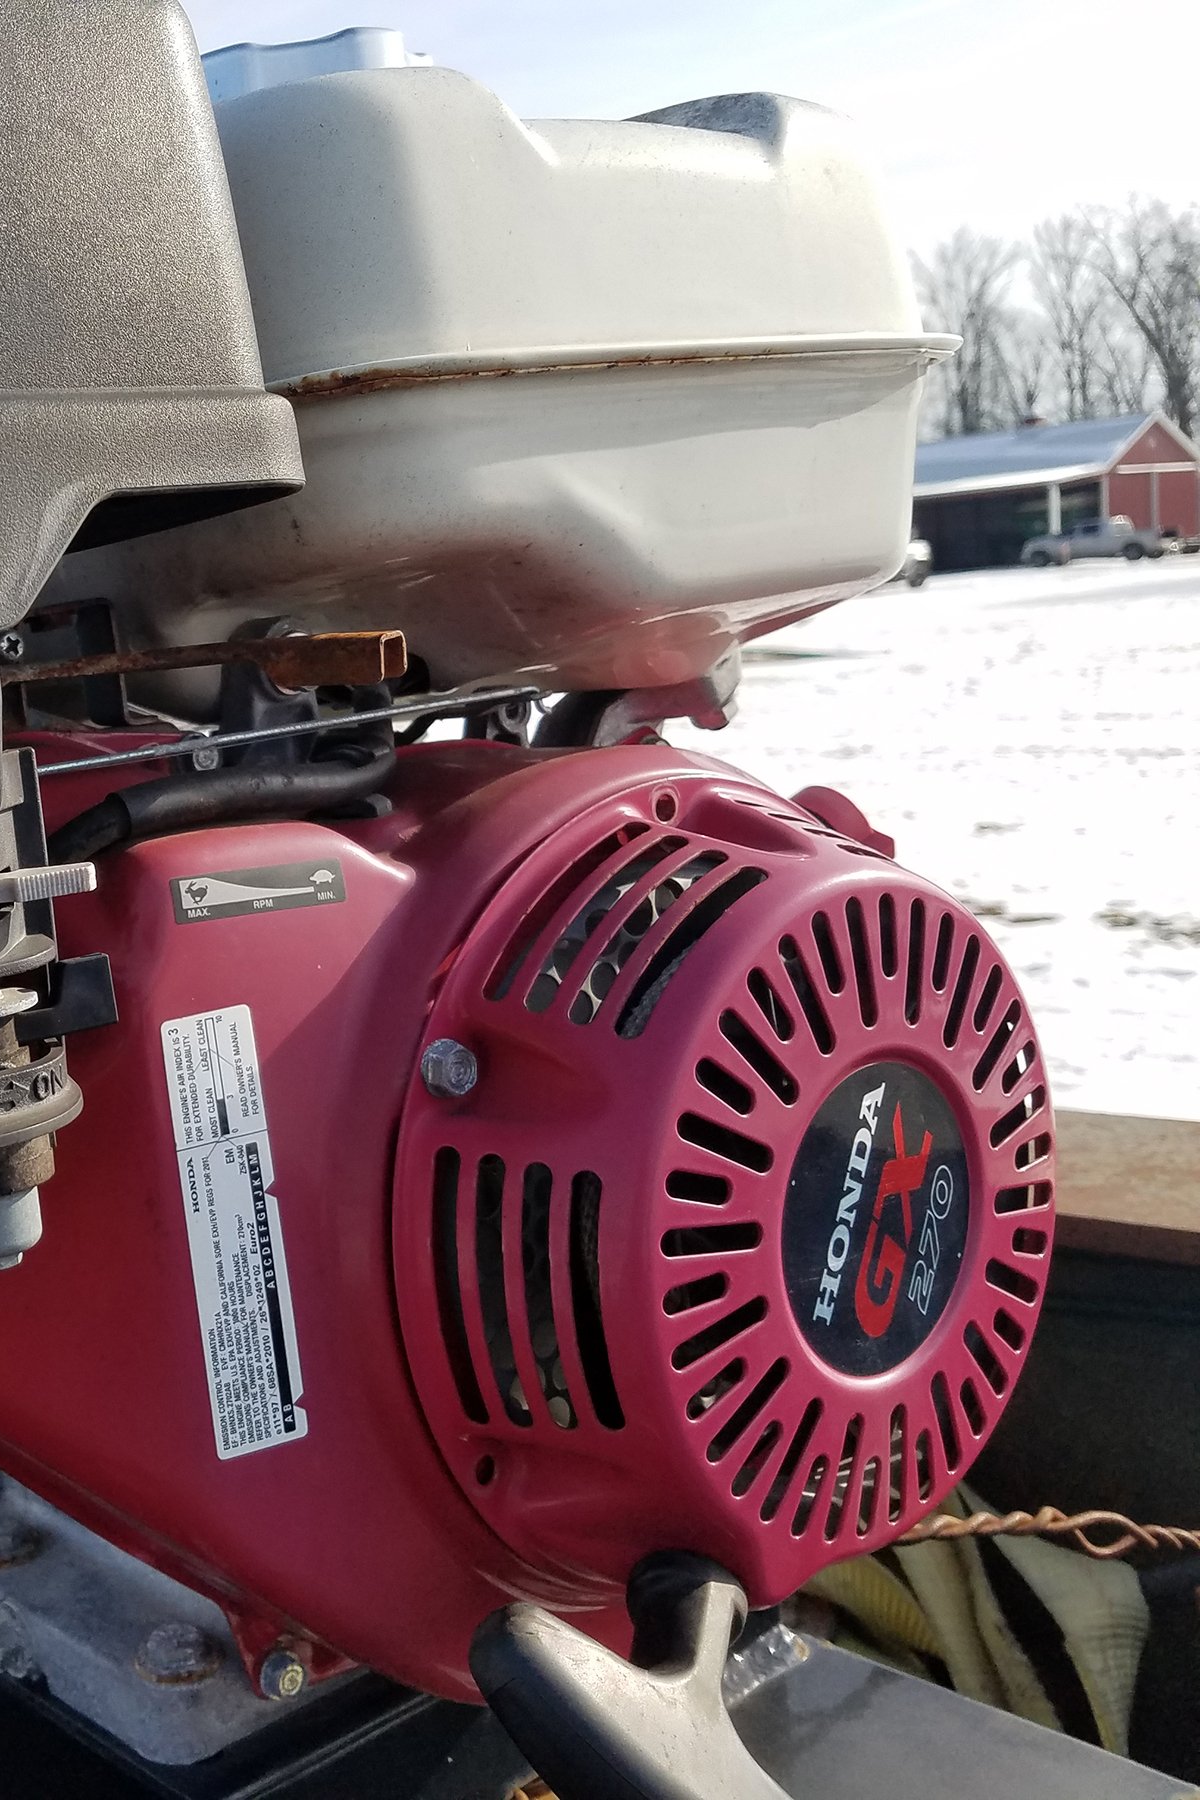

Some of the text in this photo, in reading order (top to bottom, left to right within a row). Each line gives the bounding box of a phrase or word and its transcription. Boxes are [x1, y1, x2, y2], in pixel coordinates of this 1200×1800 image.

[187, 890, 336, 919] MAX. RPM MIN.
[172, 1037, 179, 1045] IS
[196, 1020, 209, 1071] LEAST CLEAN
[174, 1047, 183, 1071] INDEX
[230, 1022, 249, 1117] READ OWNER'S MANUAL
[32, 1064, 63, 1101] ON
[177, 1073, 185, 1086] AIR
[182, 1034, 204, 1141] FOR EXTENDED DURABILITY.
[246, 1066, 259, 1115] FOR DETAILS.
[179, 1088, 191, 1124] ENGINE'S
[205, 1088, 219, 1138] MOST CLEAN
[185, 1127, 193, 1144] THIS
[224, 1148, 235, 1164] EM
[187, 1158, 199, 1213] HONDA
[204, 1173, 212, 1186] FOR
[206, 1188, 214, 1206] REGS
[813, 1082, 886, 1326] HONDA
[209, 1209, 219, 1238] EXH/EVP
[855, 1100, 933, 1338] GX
[213, 1240, 222, 1258] SORE
[247, 1223, 258, 1254] Euro2
[908, 1165, 953, 1316] 270
[216, 1260, 227, 1300] CALIFORNIA
[227, 1281, 237, 1306] HOURS
[232, 1253, 245, 1305] MAINTENANCE
[222, 1302, 230, 1316] AND
[224, 1319, 234, 1347] EXH/EVP
[242, 1322, 252, 1355] MANUAL
[228, 1349, 236, 1362] EPA
[238, 1356, 250, 1401] COMPLIANCE
[247, 1357, 257, 1389] OWNER'S
[256, 1365, 264, 1380] AND
[208, 1329, 230, 1450] EMISSION CONTROL INFORMATION
[232, 1378, 241, 1402] MEETS
[235, 1404, 245, 1429] ENGINE
[244, 1404, 255, 1443] EMISSIONS
[253, 1407, 260, 1418] TO
[258, 1383, 272, 1438] SPECIFICATIONS
[255, 1419, 263, 1441] REFER
